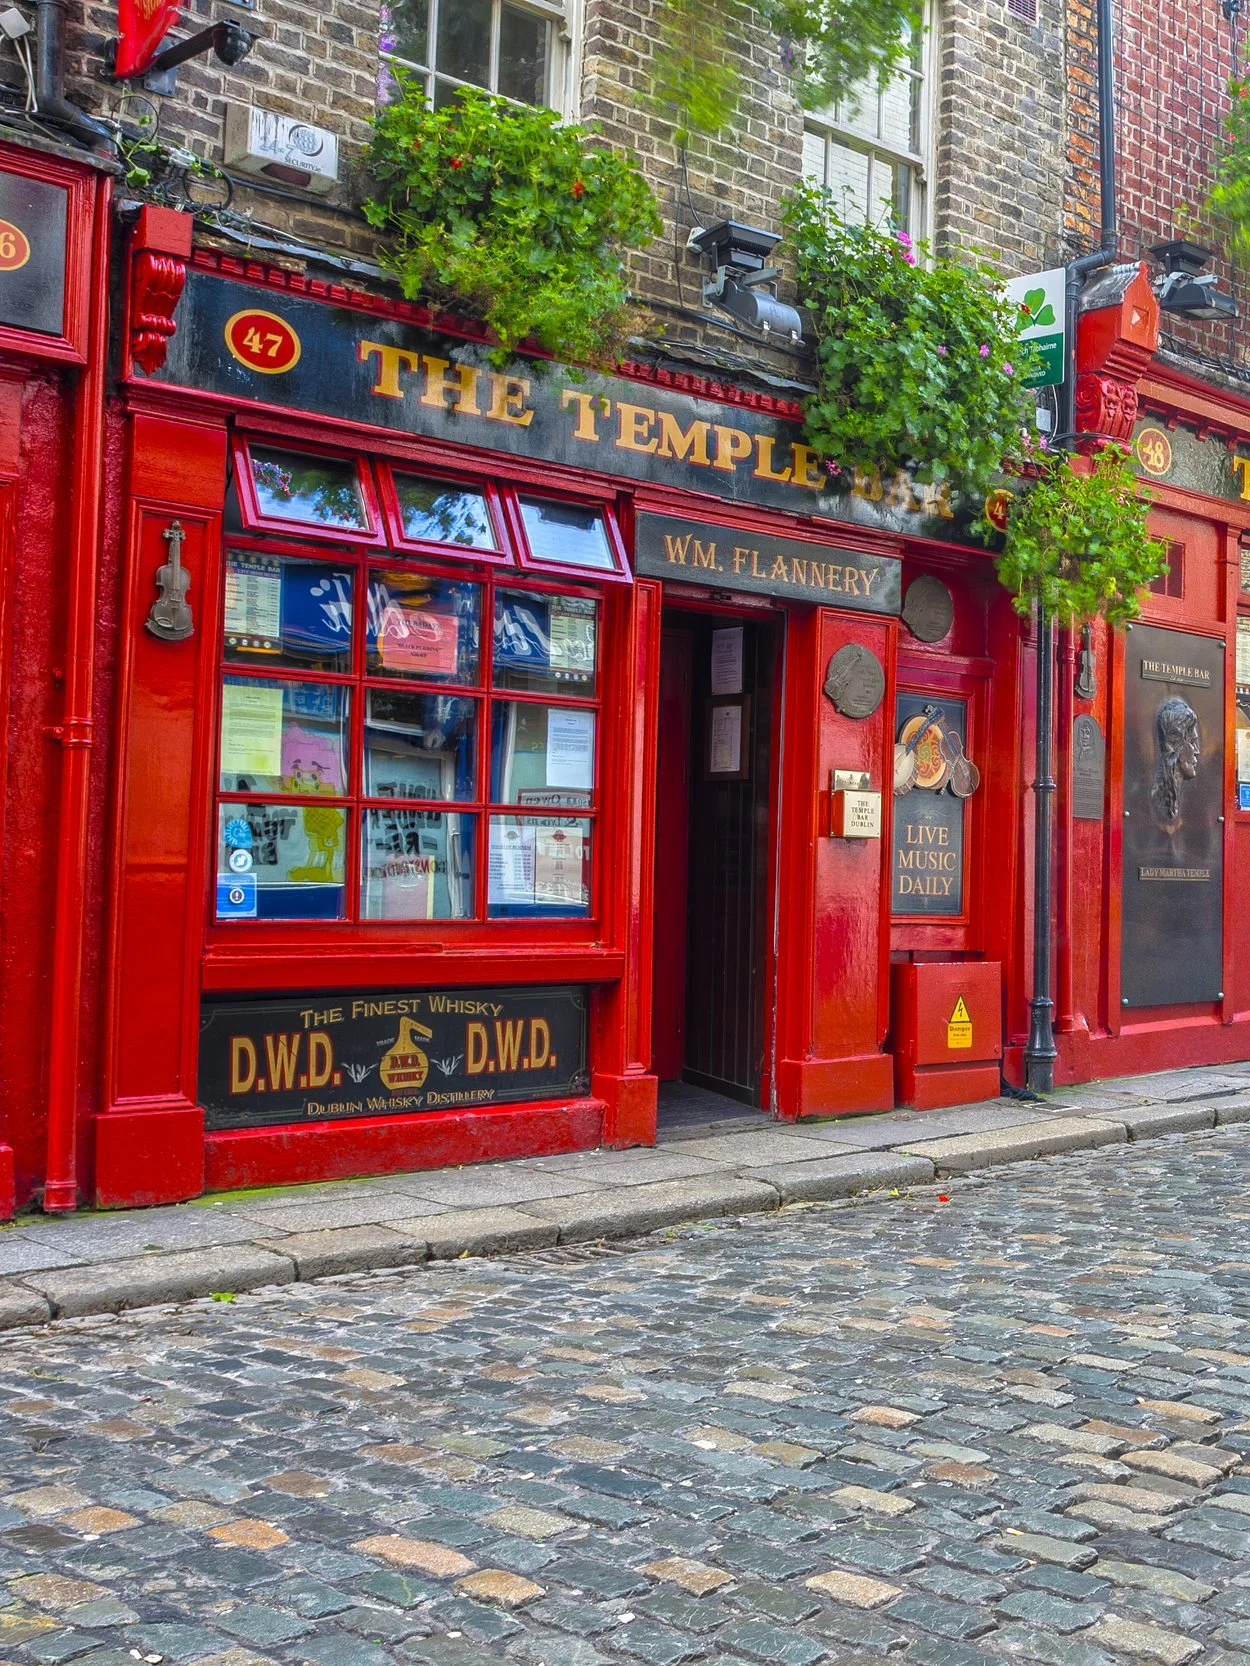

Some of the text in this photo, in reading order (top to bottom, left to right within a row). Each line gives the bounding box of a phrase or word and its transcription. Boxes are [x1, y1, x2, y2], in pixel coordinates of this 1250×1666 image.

[242, 326, 283, 357] 47
[357, 340, 535, 426] THE
[561, 389, 827, 490] TEMPLE
[1143, 438, 1165, 468] 48
[664, 533, 880, 597] WM. FLANNERY
[1143, 660, 1161, 672] THE
[1161, 663, 1193, 677] TEMPLE
[1194, 668, 1211, 680] BAR
[851, 820, 875, 828] DUBLIN
[906, 824, 949, 846] LIVE
[898, 849, 956, 871] MUSIC
[1140, 868, 1210, 878] LADY MARTHA TEMPLE
[898, 875, 954, 895] DAILY
[300, 995, 504, 1029] THE FINEST WHISKY
[464, 1016, 558, 1076] D.W.D.
[230, 1031, 342, 1096] D.W.D.
[307, 1101, 362, 1116] DUBLIN
[366, 1096, 425, 1112] WHISKY
[426, 1088, 495, 1106] DISTILLERY
